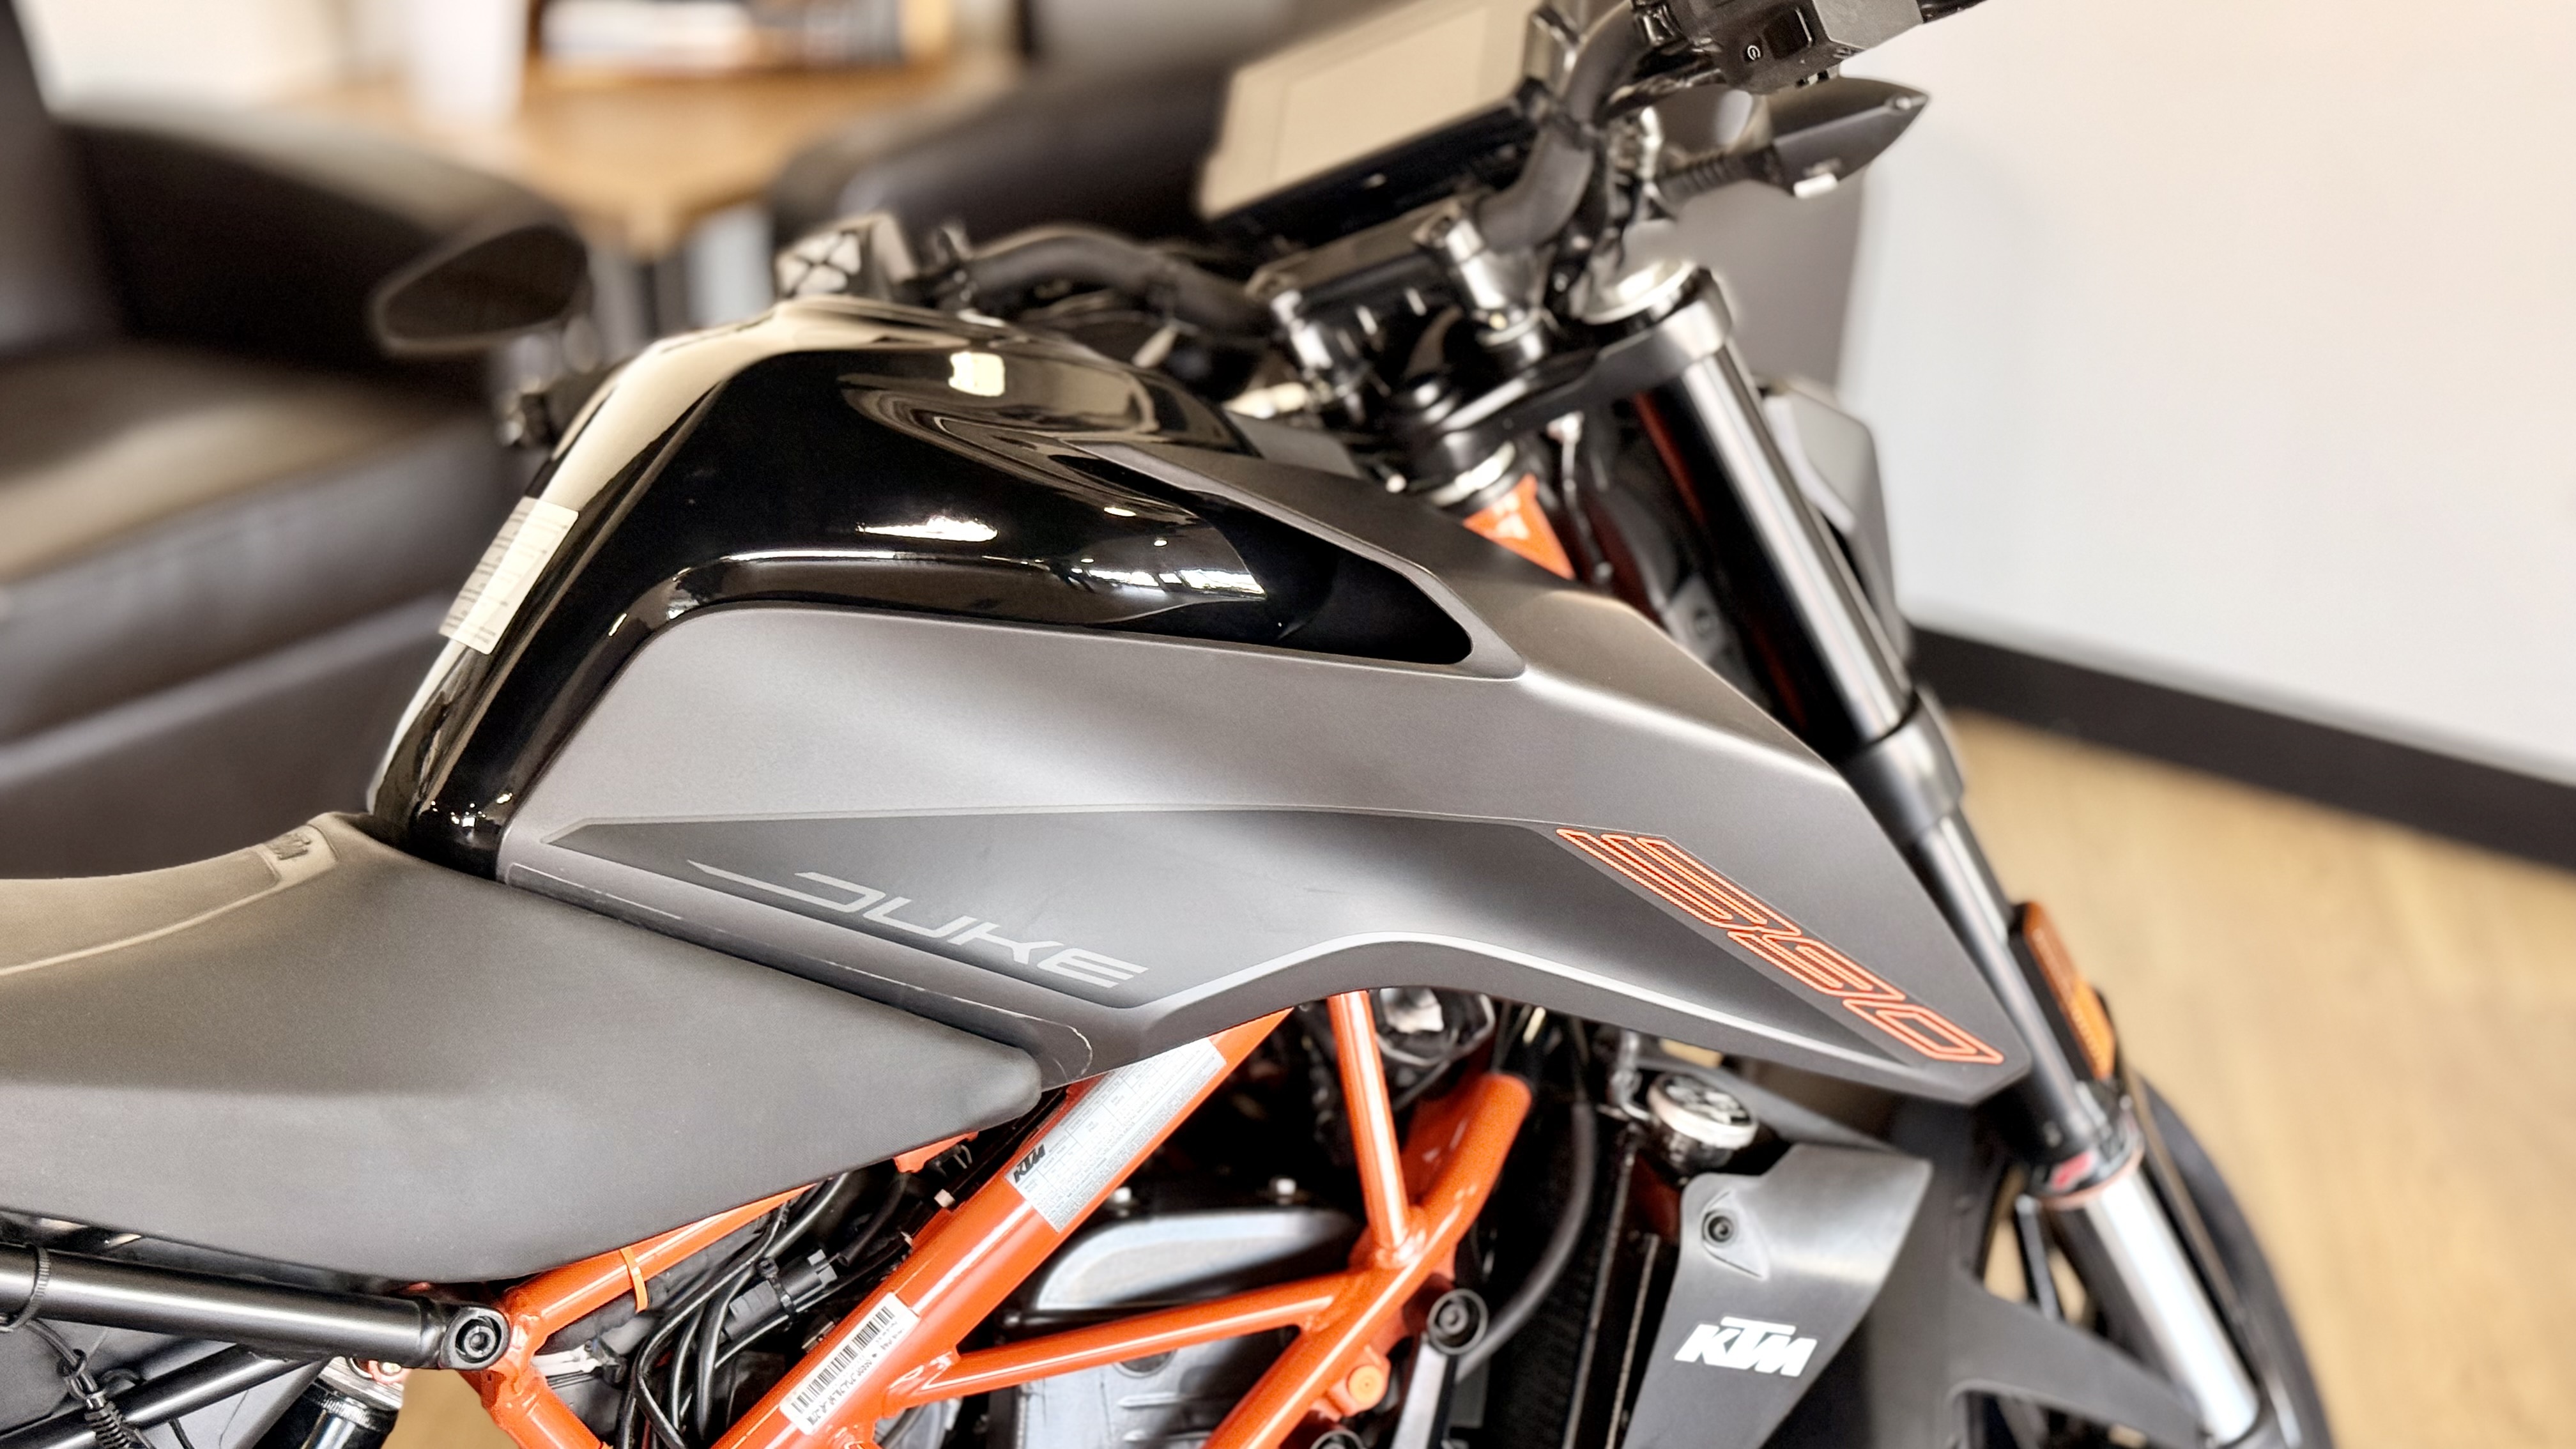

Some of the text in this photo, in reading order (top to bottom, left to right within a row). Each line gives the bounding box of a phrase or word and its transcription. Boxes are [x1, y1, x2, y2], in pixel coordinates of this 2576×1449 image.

[687, 859, 1149, 988] DUKE
[1013, 1144, 1046, 1183] KTM
[1675, 1316, 1818, 1377] KTM
